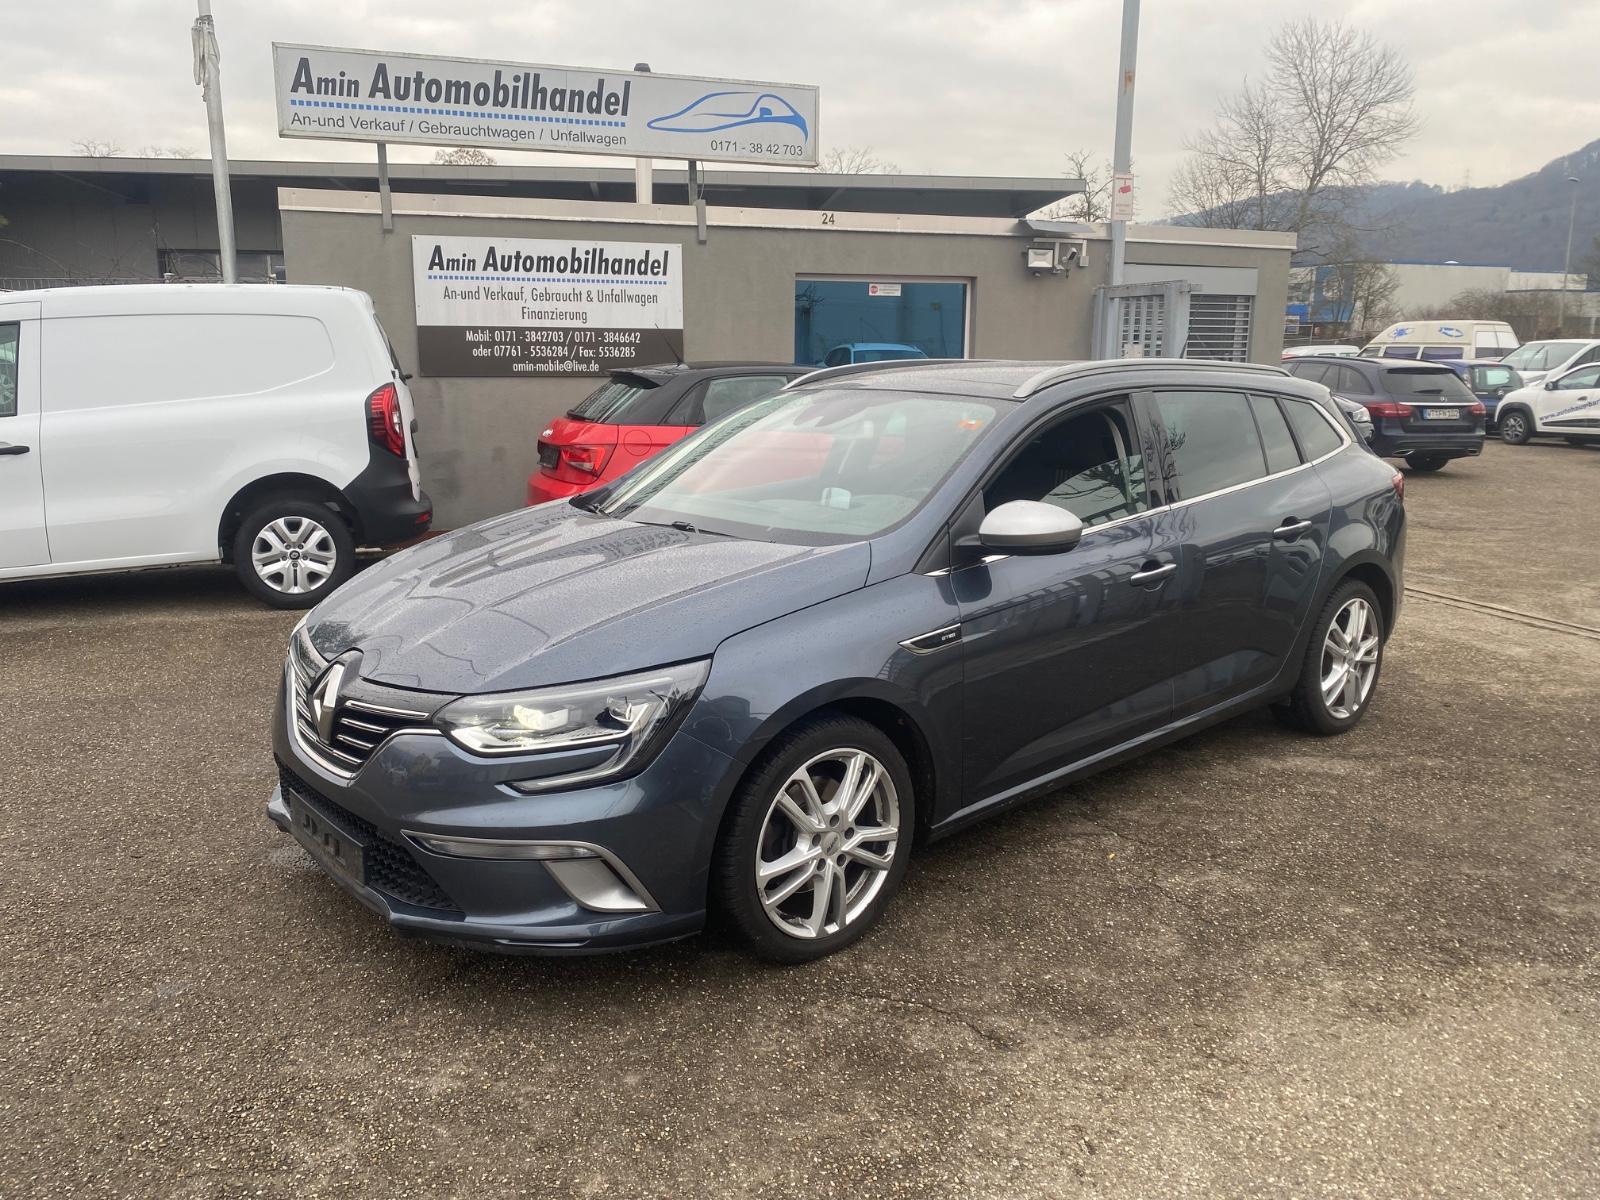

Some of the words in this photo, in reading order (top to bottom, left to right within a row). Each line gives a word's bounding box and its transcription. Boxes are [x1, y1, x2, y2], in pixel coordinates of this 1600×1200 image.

[290, 57, 360, 98] Amin
[368, 63, 631, 117] Automobilhandel
[291, 112, 345, 128] An-und
[350, 116, 405, 132] Verkauf
[418, 120, 535, 142] Gebrauchtwagen
[550, 129, 627, 147] Unfallwagen
[710, 139, 737, 152] 0171
[749, 142, 763, 153] 38
[766, 143, 780, 155] 42
[783, 144, 803, 156] 703
[821, 212, 835, 225] 24
[428, 245, 477, 271] Amin
[482, 246, 669, 276] Automobilhandel
[443, 285, 480, 300] An-und
[483, 286, 527, 303] Verkauf,
[531, 287, 582, 302] Gebraucht
[586, 289, 594, 303] &
[597, 289, 658, 307] Unfallwagen
[521, 306, 588, 324] Finanzierung
[465, 329, 492, 342] Mobil:
[494, 330, 516, 342] 0171
[525, 331, 564, 342] 3842703
[574, 331, 596, 343] 0171
[603, 332, 641, 343] 3846642
[472, 345, 492, 357] oder
[494, 345, 521, 357] 07761
[530, 346, 568, 357] 5536284
[579, 346, 596, 358] Fax:
[599, 346, 636, 358] 5536285
[513, 360, 600, 372] amin-mobile@live.de
